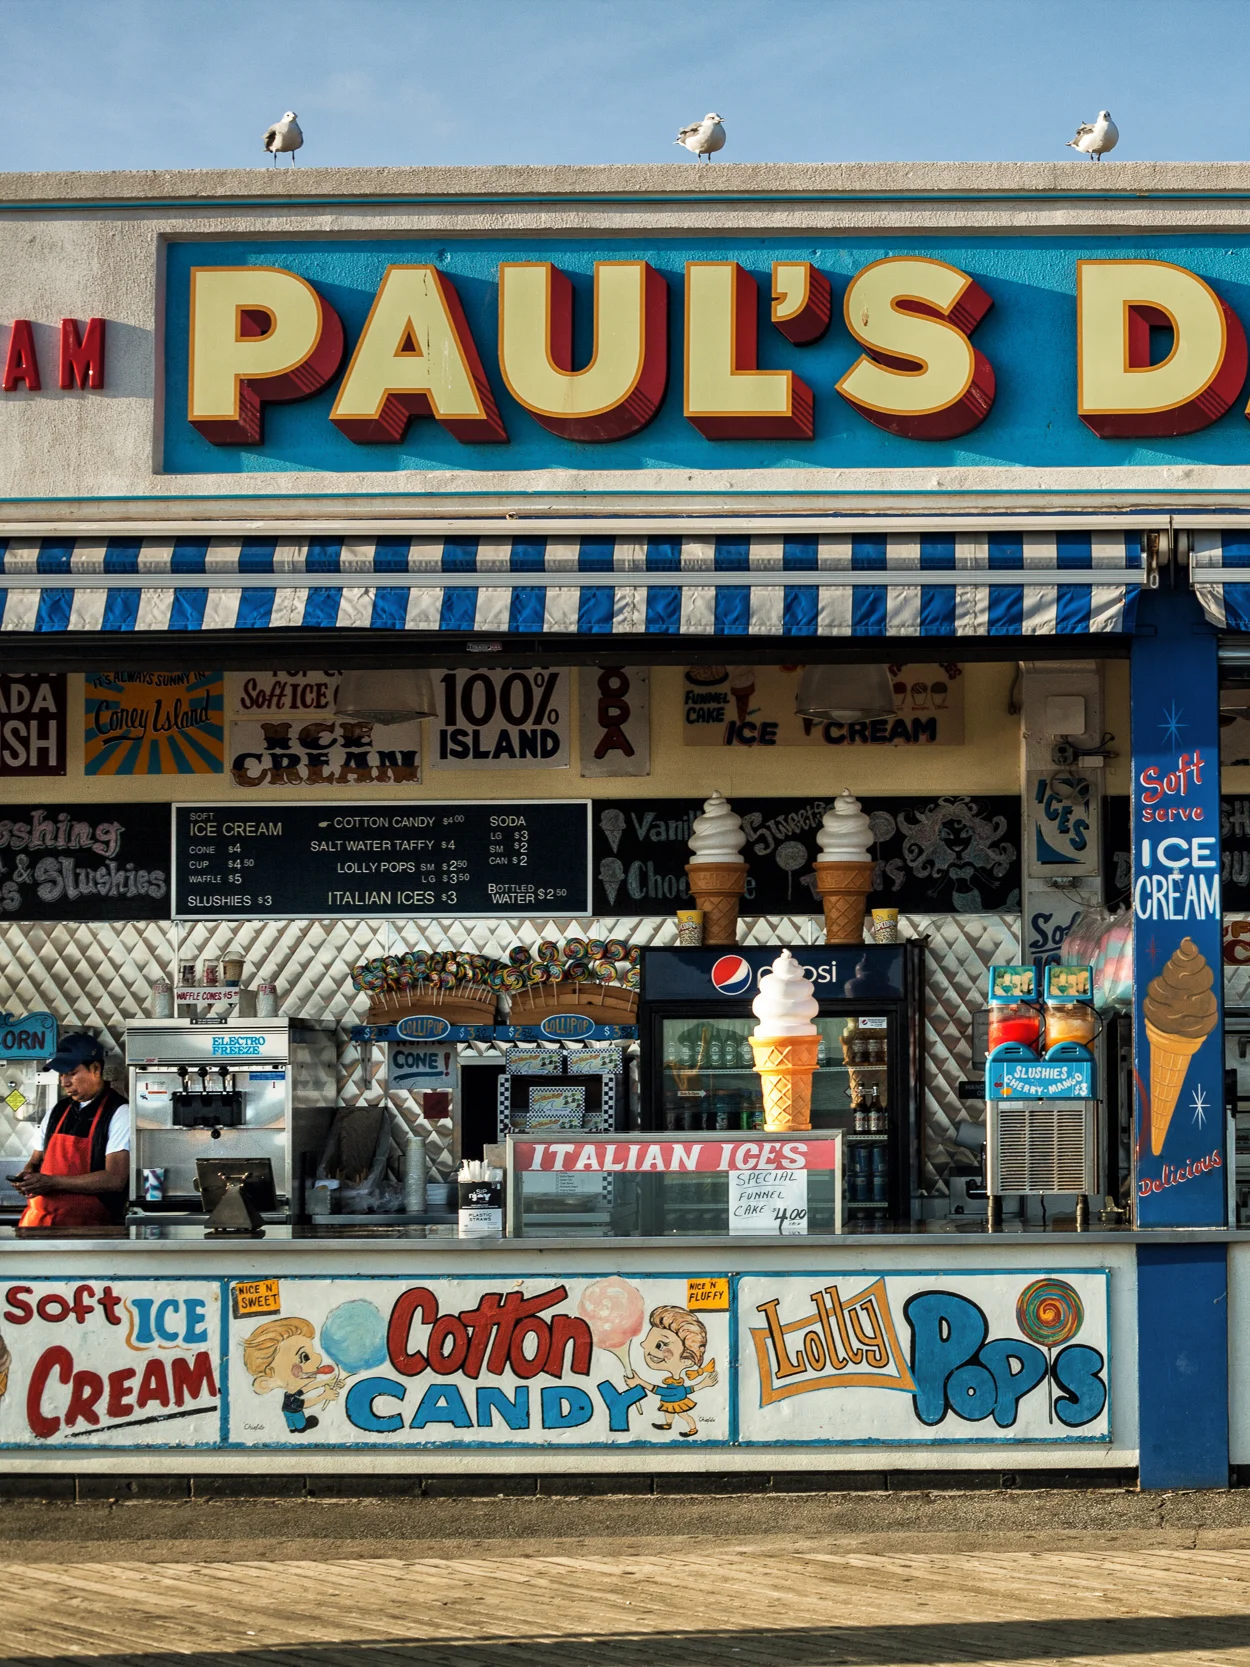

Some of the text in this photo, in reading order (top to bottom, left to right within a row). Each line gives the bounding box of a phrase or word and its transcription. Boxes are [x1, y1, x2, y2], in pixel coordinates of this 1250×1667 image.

[189, 256, 994, 446] PAUL'S
[93, 671, 112, 689] IT'S
[113, 671, 155, 687] ALWAYS
[156, 673, 190, 687] SUNNY
[241, 678, 328, 710] Soft ICE
[440, 672, 560, 727] 100%
[685, 690, 730, 706] FUNNEL
[94, 689, 212, 739] Coney Island
[686, 706, 725, 725] CAKE
[261, 721, 374, 752] ICE
[723, 715, 938, 747] ICE CREAM
[440, 729, 560, 760] ISLAND
[230, 750, 421, 788] CREAM
[1140, 749, 1206, 805] Soft
[189, 812, 214, 821] SOFT
[334, 816, 435, 828] COTTON CANDY
[489, 815, 526, 827] SODA
[1142, 806, 1206, 823] serve
[190, 822, 281, 837] ICE CREAM
[188, 843, 241, 855] CONE $4
[310, 839, 455, 852] SALT WATER TAFFY $4
[1142, 836, 1217, 870] ICE
[188, 860, 209, 869] CUP
[337, 861, 415, 874] LOLLY POPS
[13, 853, 168, 903] & Slushies
[188, 873, 241, 885] WAFFLE $5
[487, 883, 536, 894] BOTTLED
[1135, 872, 1220, 920] CREAM
[187, 894, 272, 907] SLUSHIES $3
[328, 890, 457, 905] ITALIAN ICES $3
[491, 893, 534, 904] WATER
[176, 990, 222, 1001] WAFFLE CONES
[401, 1018, 446, 1036] LOLLIPOP
[544, 1017, 590, 1035] LOLLIPOP
[211, 1036, 266, 1046] ELECTRO
[211, 1045, 263, 1056] FREEZE
[1013, 1065, 1069, 1080] SLUSHIES
[1073, 1083, 1089, 1098] $3
[529, 1142, 810, 1171] ITALIAN ICES
[736, 1171, 799, 1187] SPECIAL
[1137, 1148, 1224, 1197] Delicious
[738, 1190, 785, 1202] FUNNEL
[733, 1204, 767, 1217] CAKE
[238, 1284, 261, 1297] NICE
[689, 1282, 706, 1292] NICE
[4, 1284, 122, 1326] Soft
[241, 1292, 279, 1309] SWEET
[689, 1290, 725, 1305] FLUFFY
[130, 1298, 209, 1346] ICE
[386, 1284, 594, 1380] Cotton
[756, 1284, 890, 1380] Lolly
[26, 1344, 219, 1439] CREAM
[345, 1376, 648, 1433] CANDY
